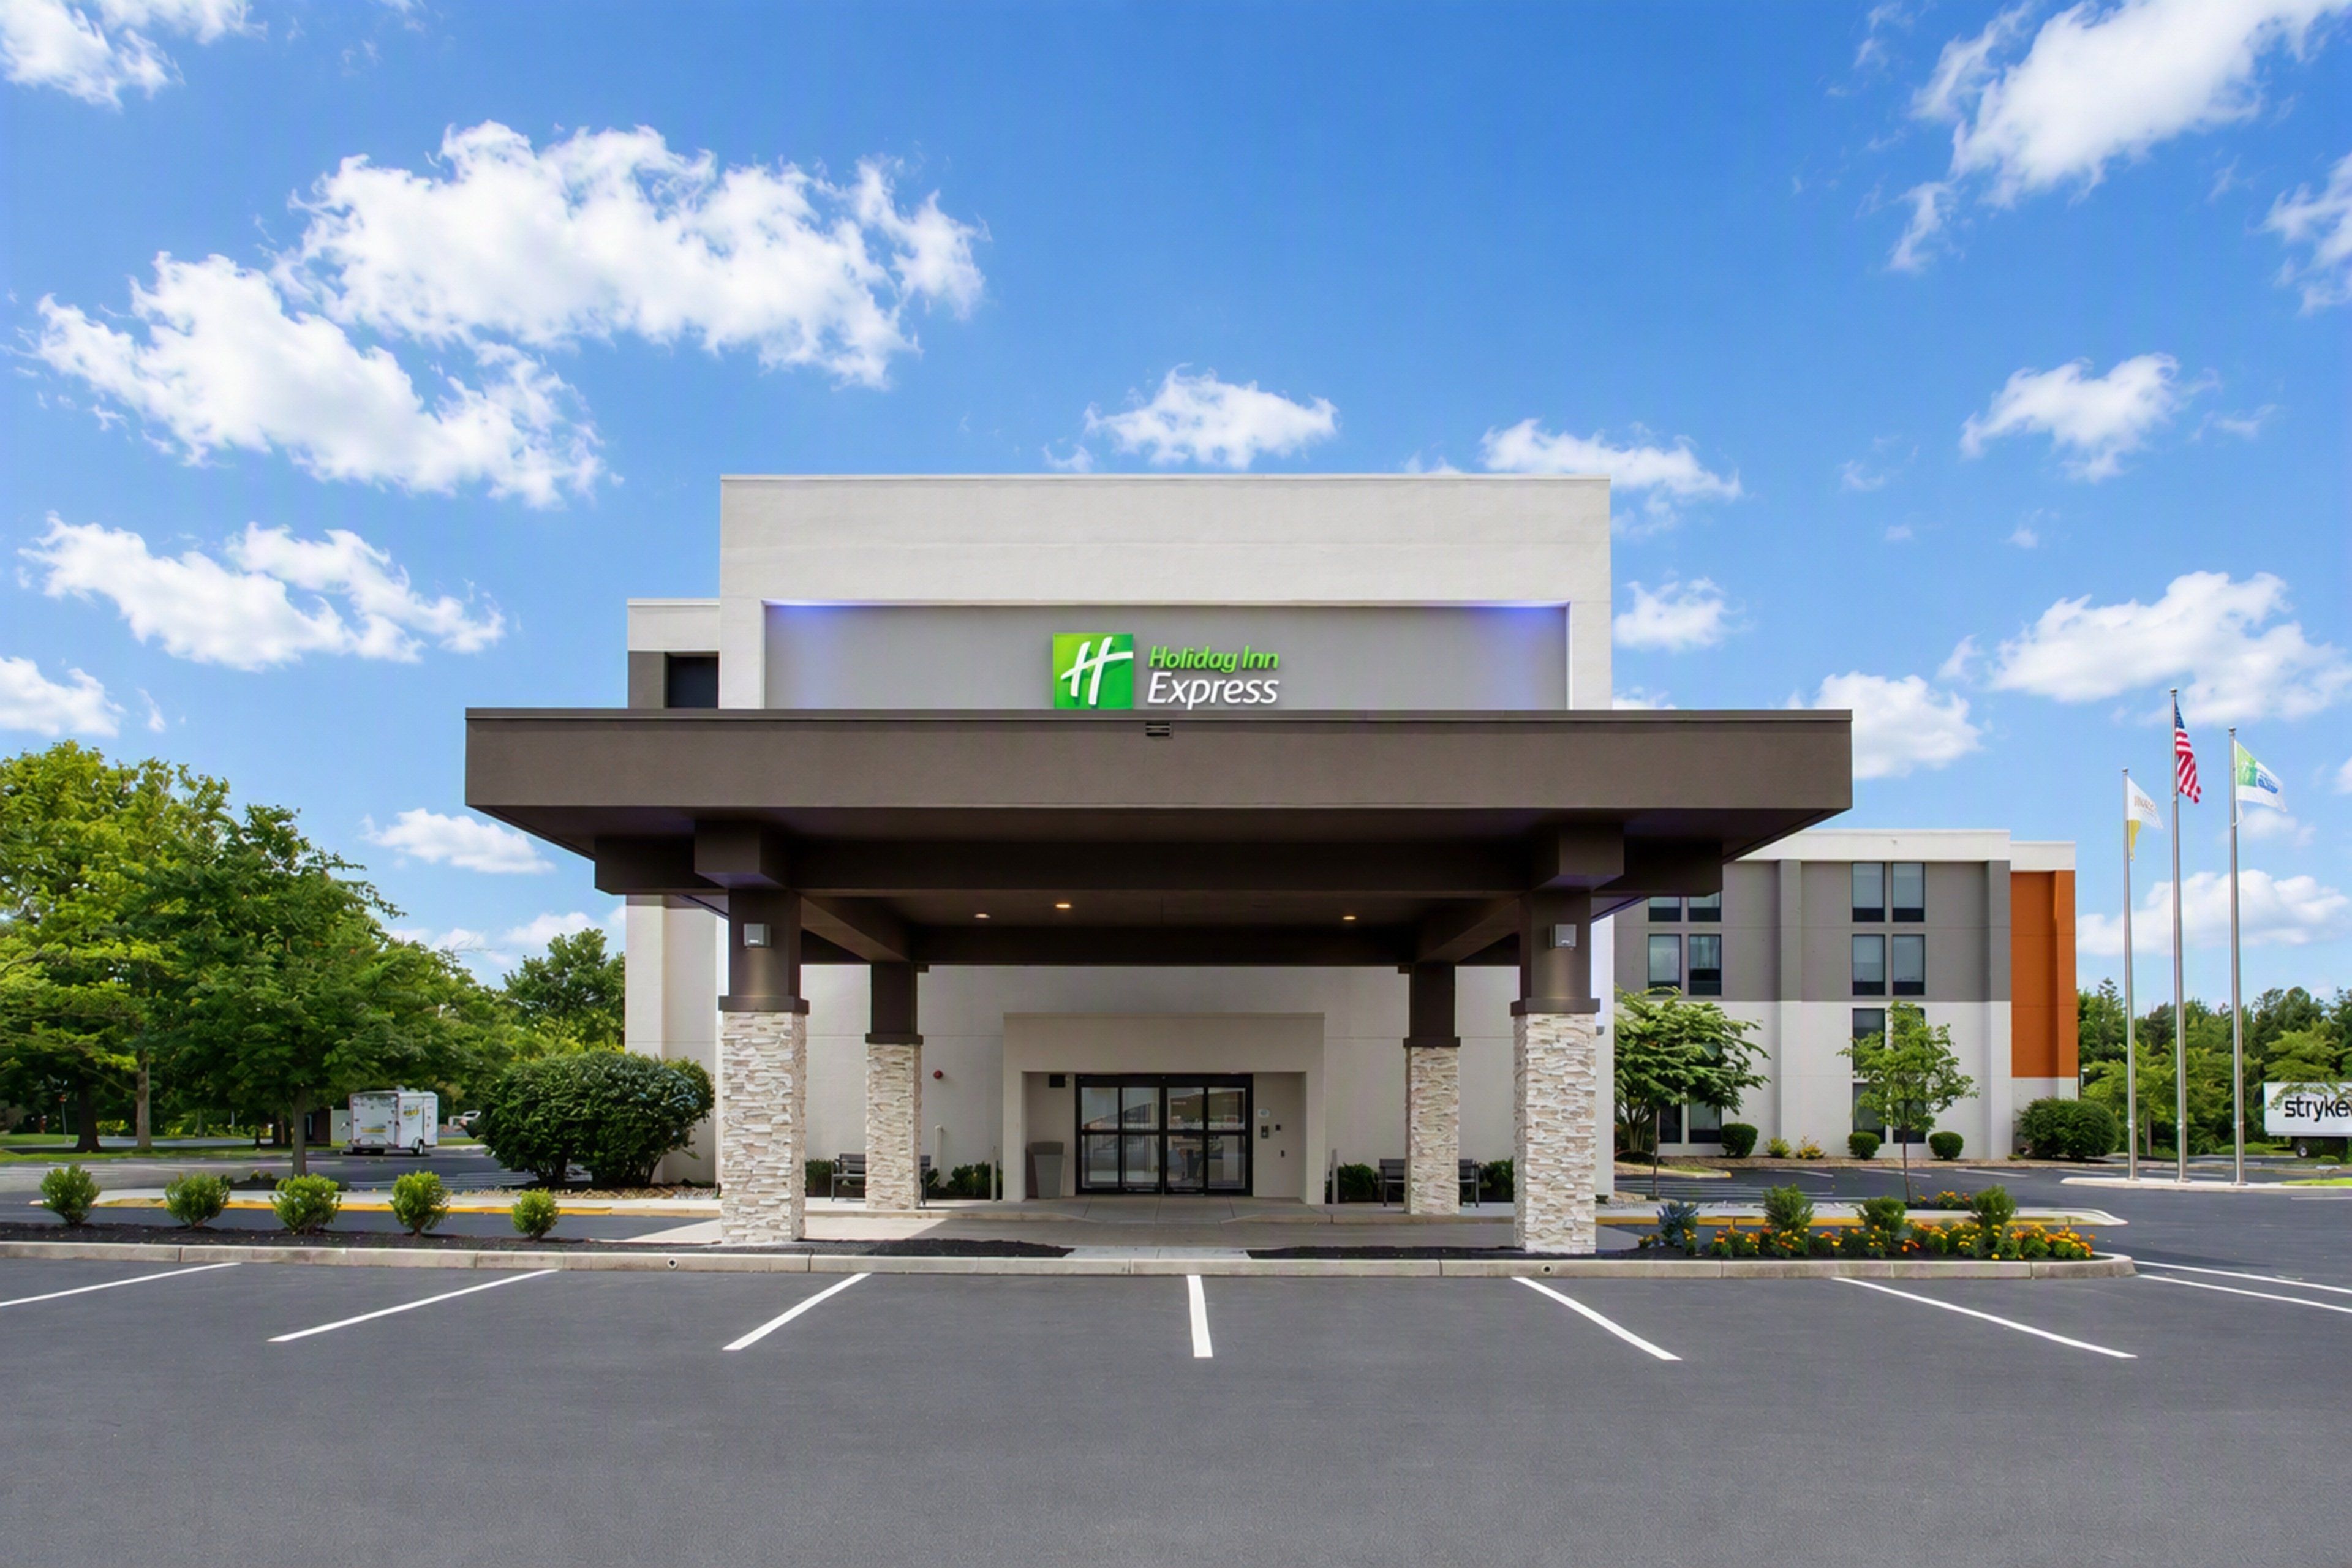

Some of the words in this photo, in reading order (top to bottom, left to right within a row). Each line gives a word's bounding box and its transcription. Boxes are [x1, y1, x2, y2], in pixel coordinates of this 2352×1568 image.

[1148, 645, 1238, 673] Holiday
[1242, 644, 1280, 669] Inn
[1147, 671, 1280, 710] Express
